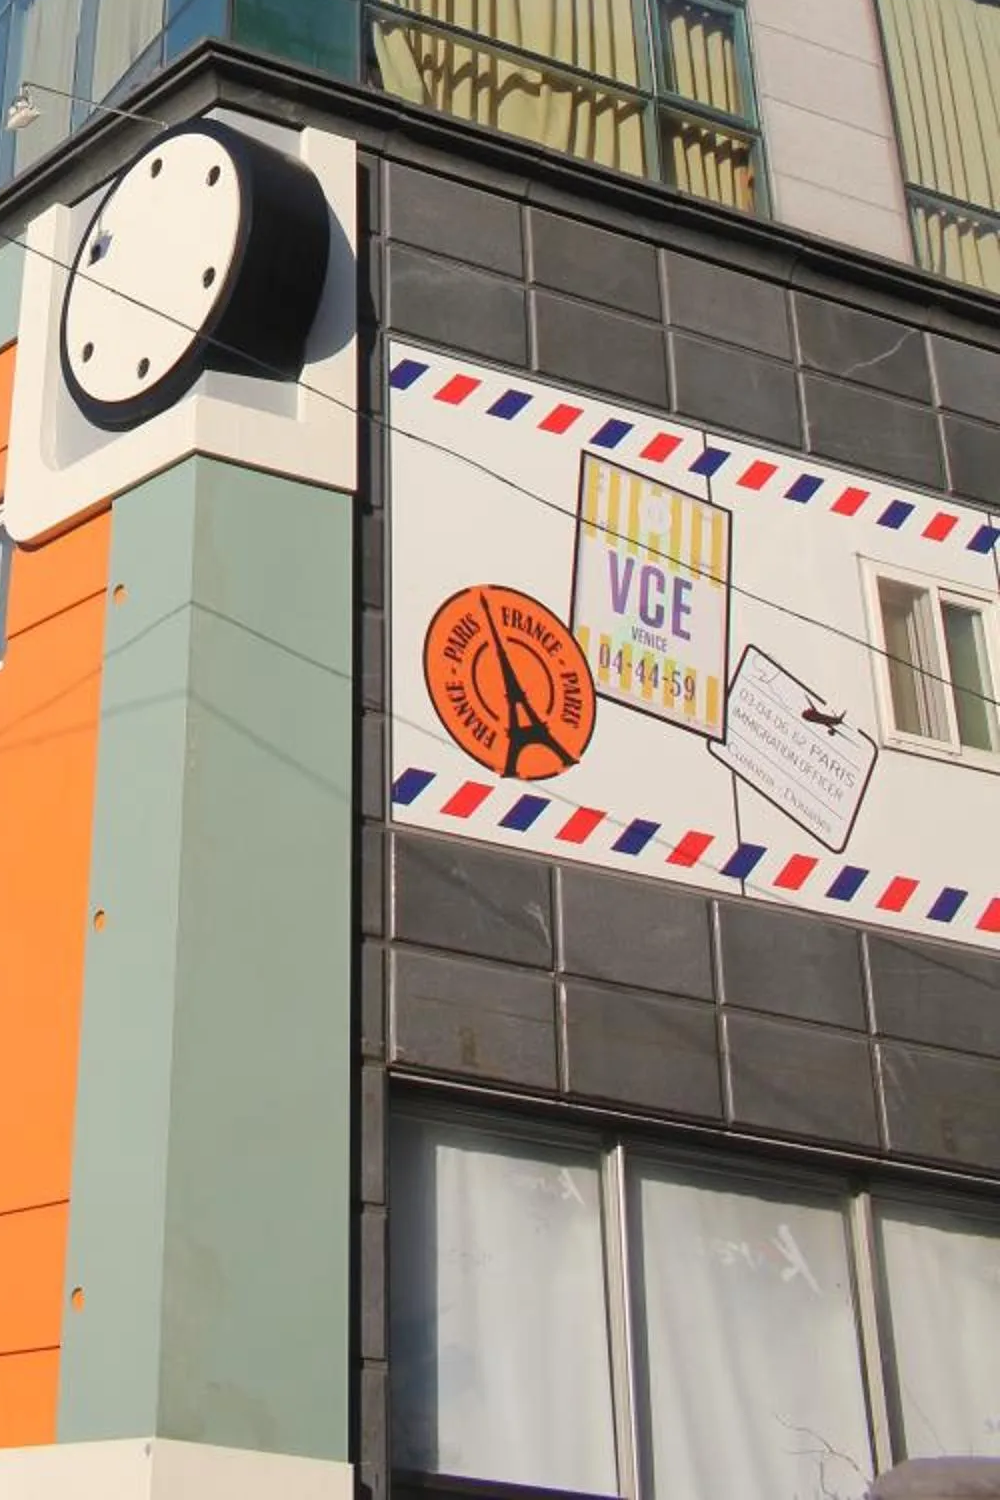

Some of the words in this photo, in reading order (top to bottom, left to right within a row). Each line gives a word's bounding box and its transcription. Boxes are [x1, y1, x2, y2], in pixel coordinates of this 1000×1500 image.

[608, 550, 693, 642] VCE
[444, 612, 481, 663] PARIS
[501, 606, 563, 657] FRANCE
[560, 671, 582, 728] PARIS
[631, 626, 668, 653] VENICE
[599, 642, 697, 702] 04-44-59
[445, 680, 497, 750] FRANCE
[809, 744, 856, 788] PARIS
